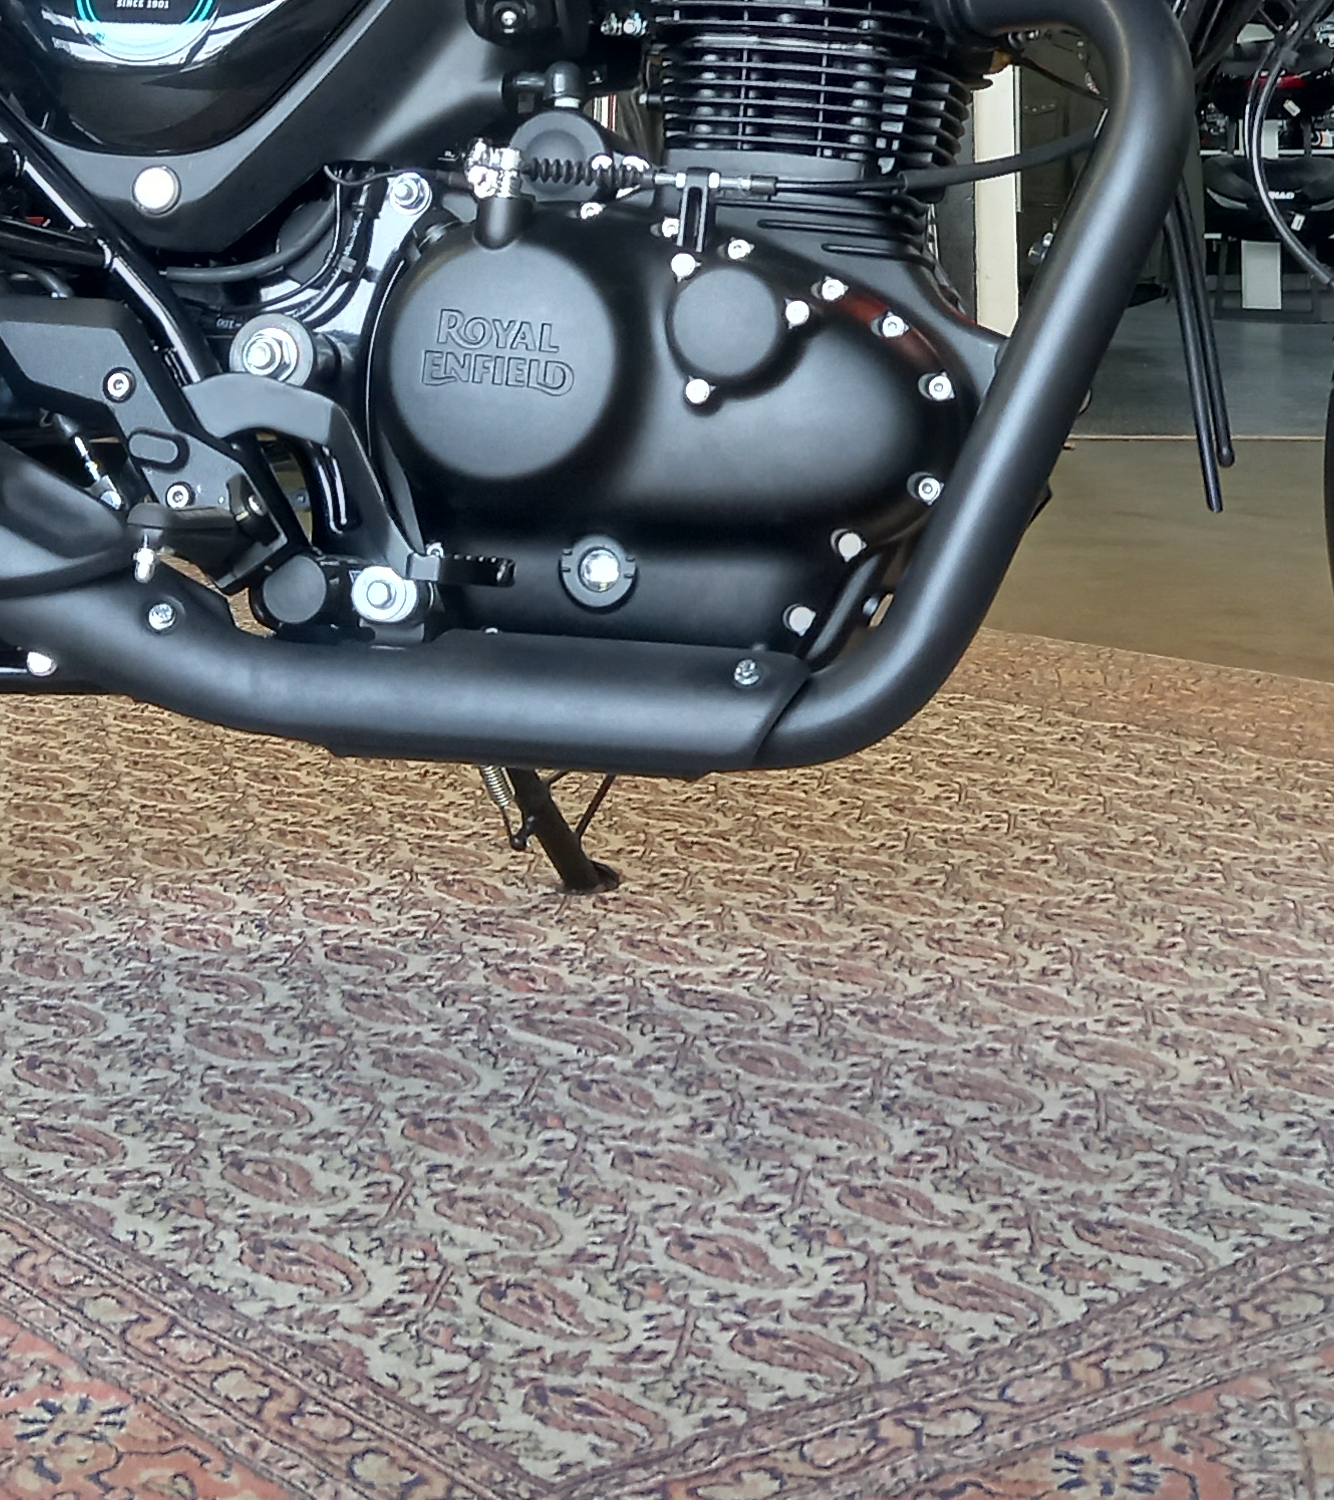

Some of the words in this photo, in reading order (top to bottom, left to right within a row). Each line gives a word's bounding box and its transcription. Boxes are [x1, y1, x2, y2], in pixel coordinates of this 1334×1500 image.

[146, 0, 170, 9] 1901
[437, 308, 560, 353] ROYAL
[421, 350, 575, 397] ENFIELD
